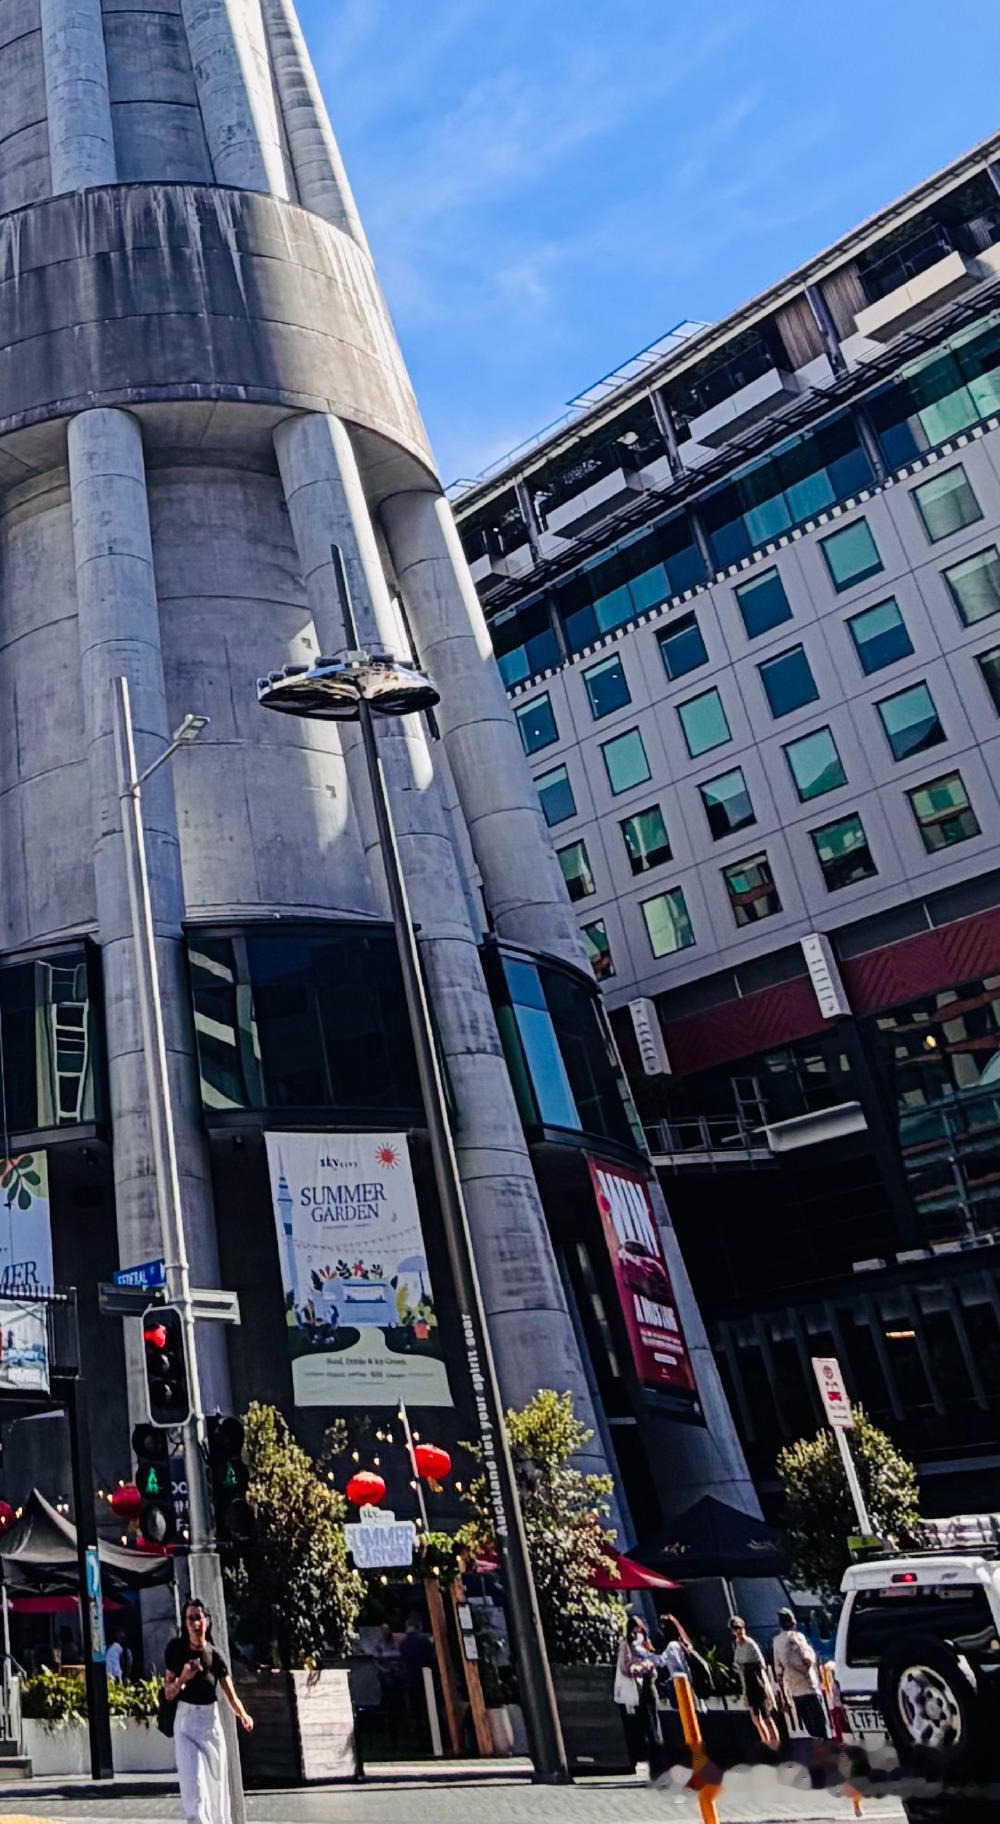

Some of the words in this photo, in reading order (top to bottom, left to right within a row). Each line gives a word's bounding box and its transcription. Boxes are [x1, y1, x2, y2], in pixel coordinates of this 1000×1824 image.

[300, 1182, 387, 1207] SUMMER
[311, 1203, 380, 1223] GARDEN
[468, 1349, 485, 1392] spirit
[475, 1395, 493, 1430] your
[483, 1434, 494, 1456] let
[486, 1460, 508, 1537] Auckland
